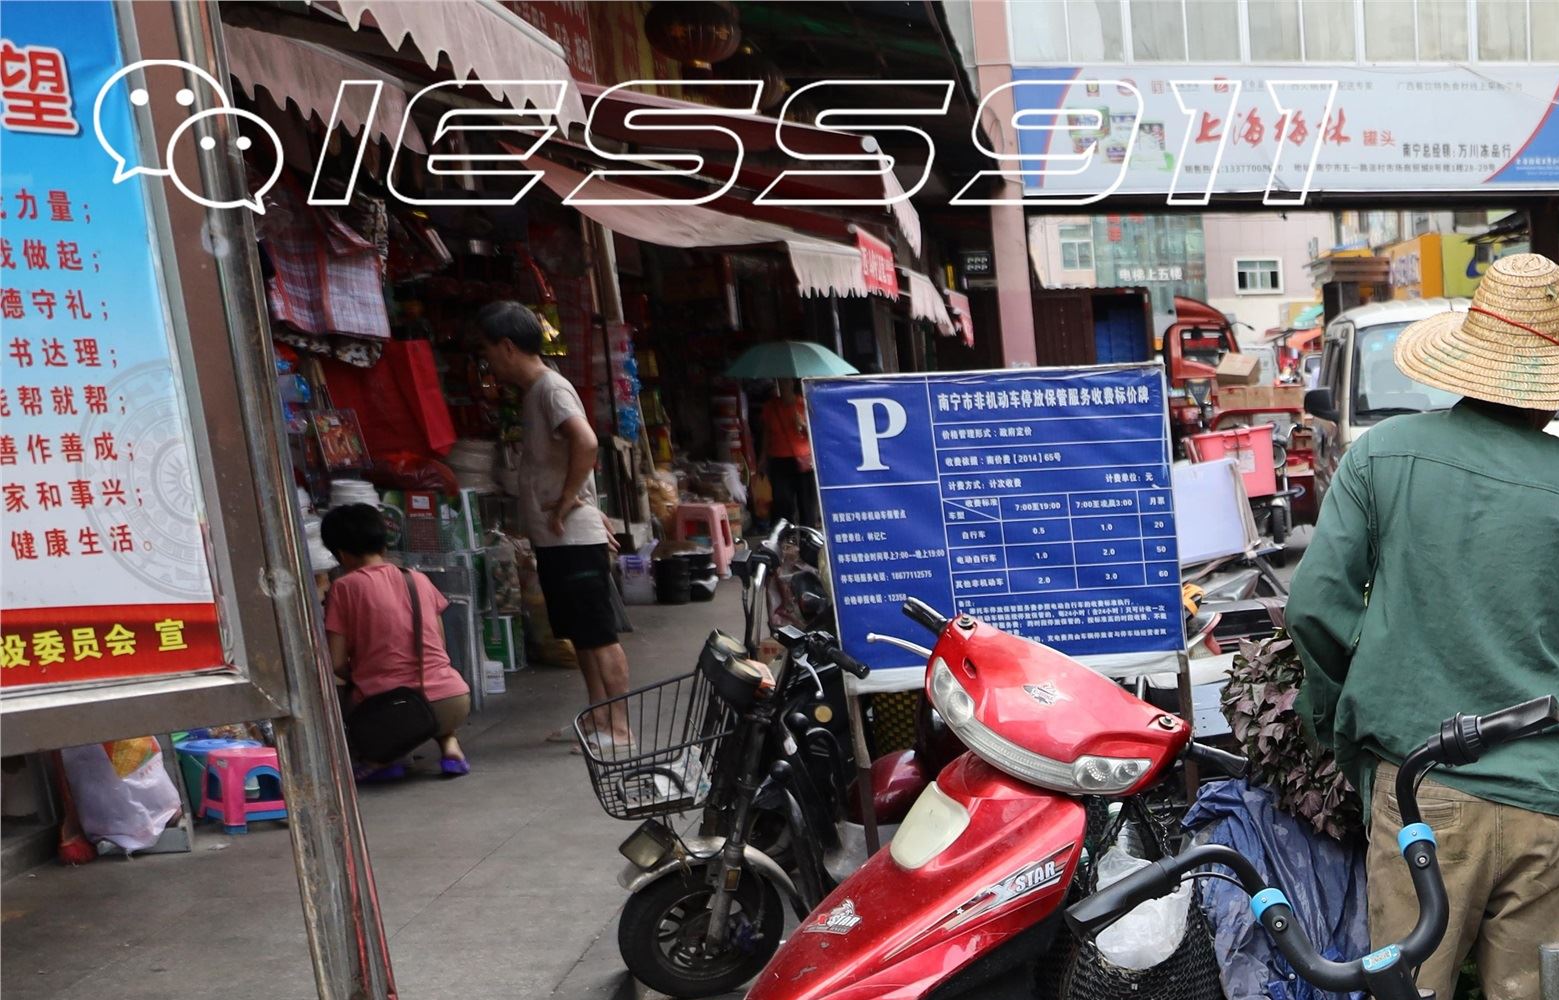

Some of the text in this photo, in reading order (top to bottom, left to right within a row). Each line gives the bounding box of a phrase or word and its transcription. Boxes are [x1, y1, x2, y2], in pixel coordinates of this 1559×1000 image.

[0, 44, 75, 131] 望
[0, 188, 92, 225] 力量;
[937, 386, 1149, 412] 南宁市非机动车停放保管服务收费标价牌
[847, 397, 907, 472] P
[961, 520, 1165, 540] 自行车 0.5 1.0 20
[956, 545, 1167, 565] 电动自行车 1.0 2.0 50
[1038, 576, 1051, 585] 2.0
[1105, 572, 1118, 581] 3.0
[1158, 570, 1169, 578] 60
[155, 618, 188, 652] 宣
